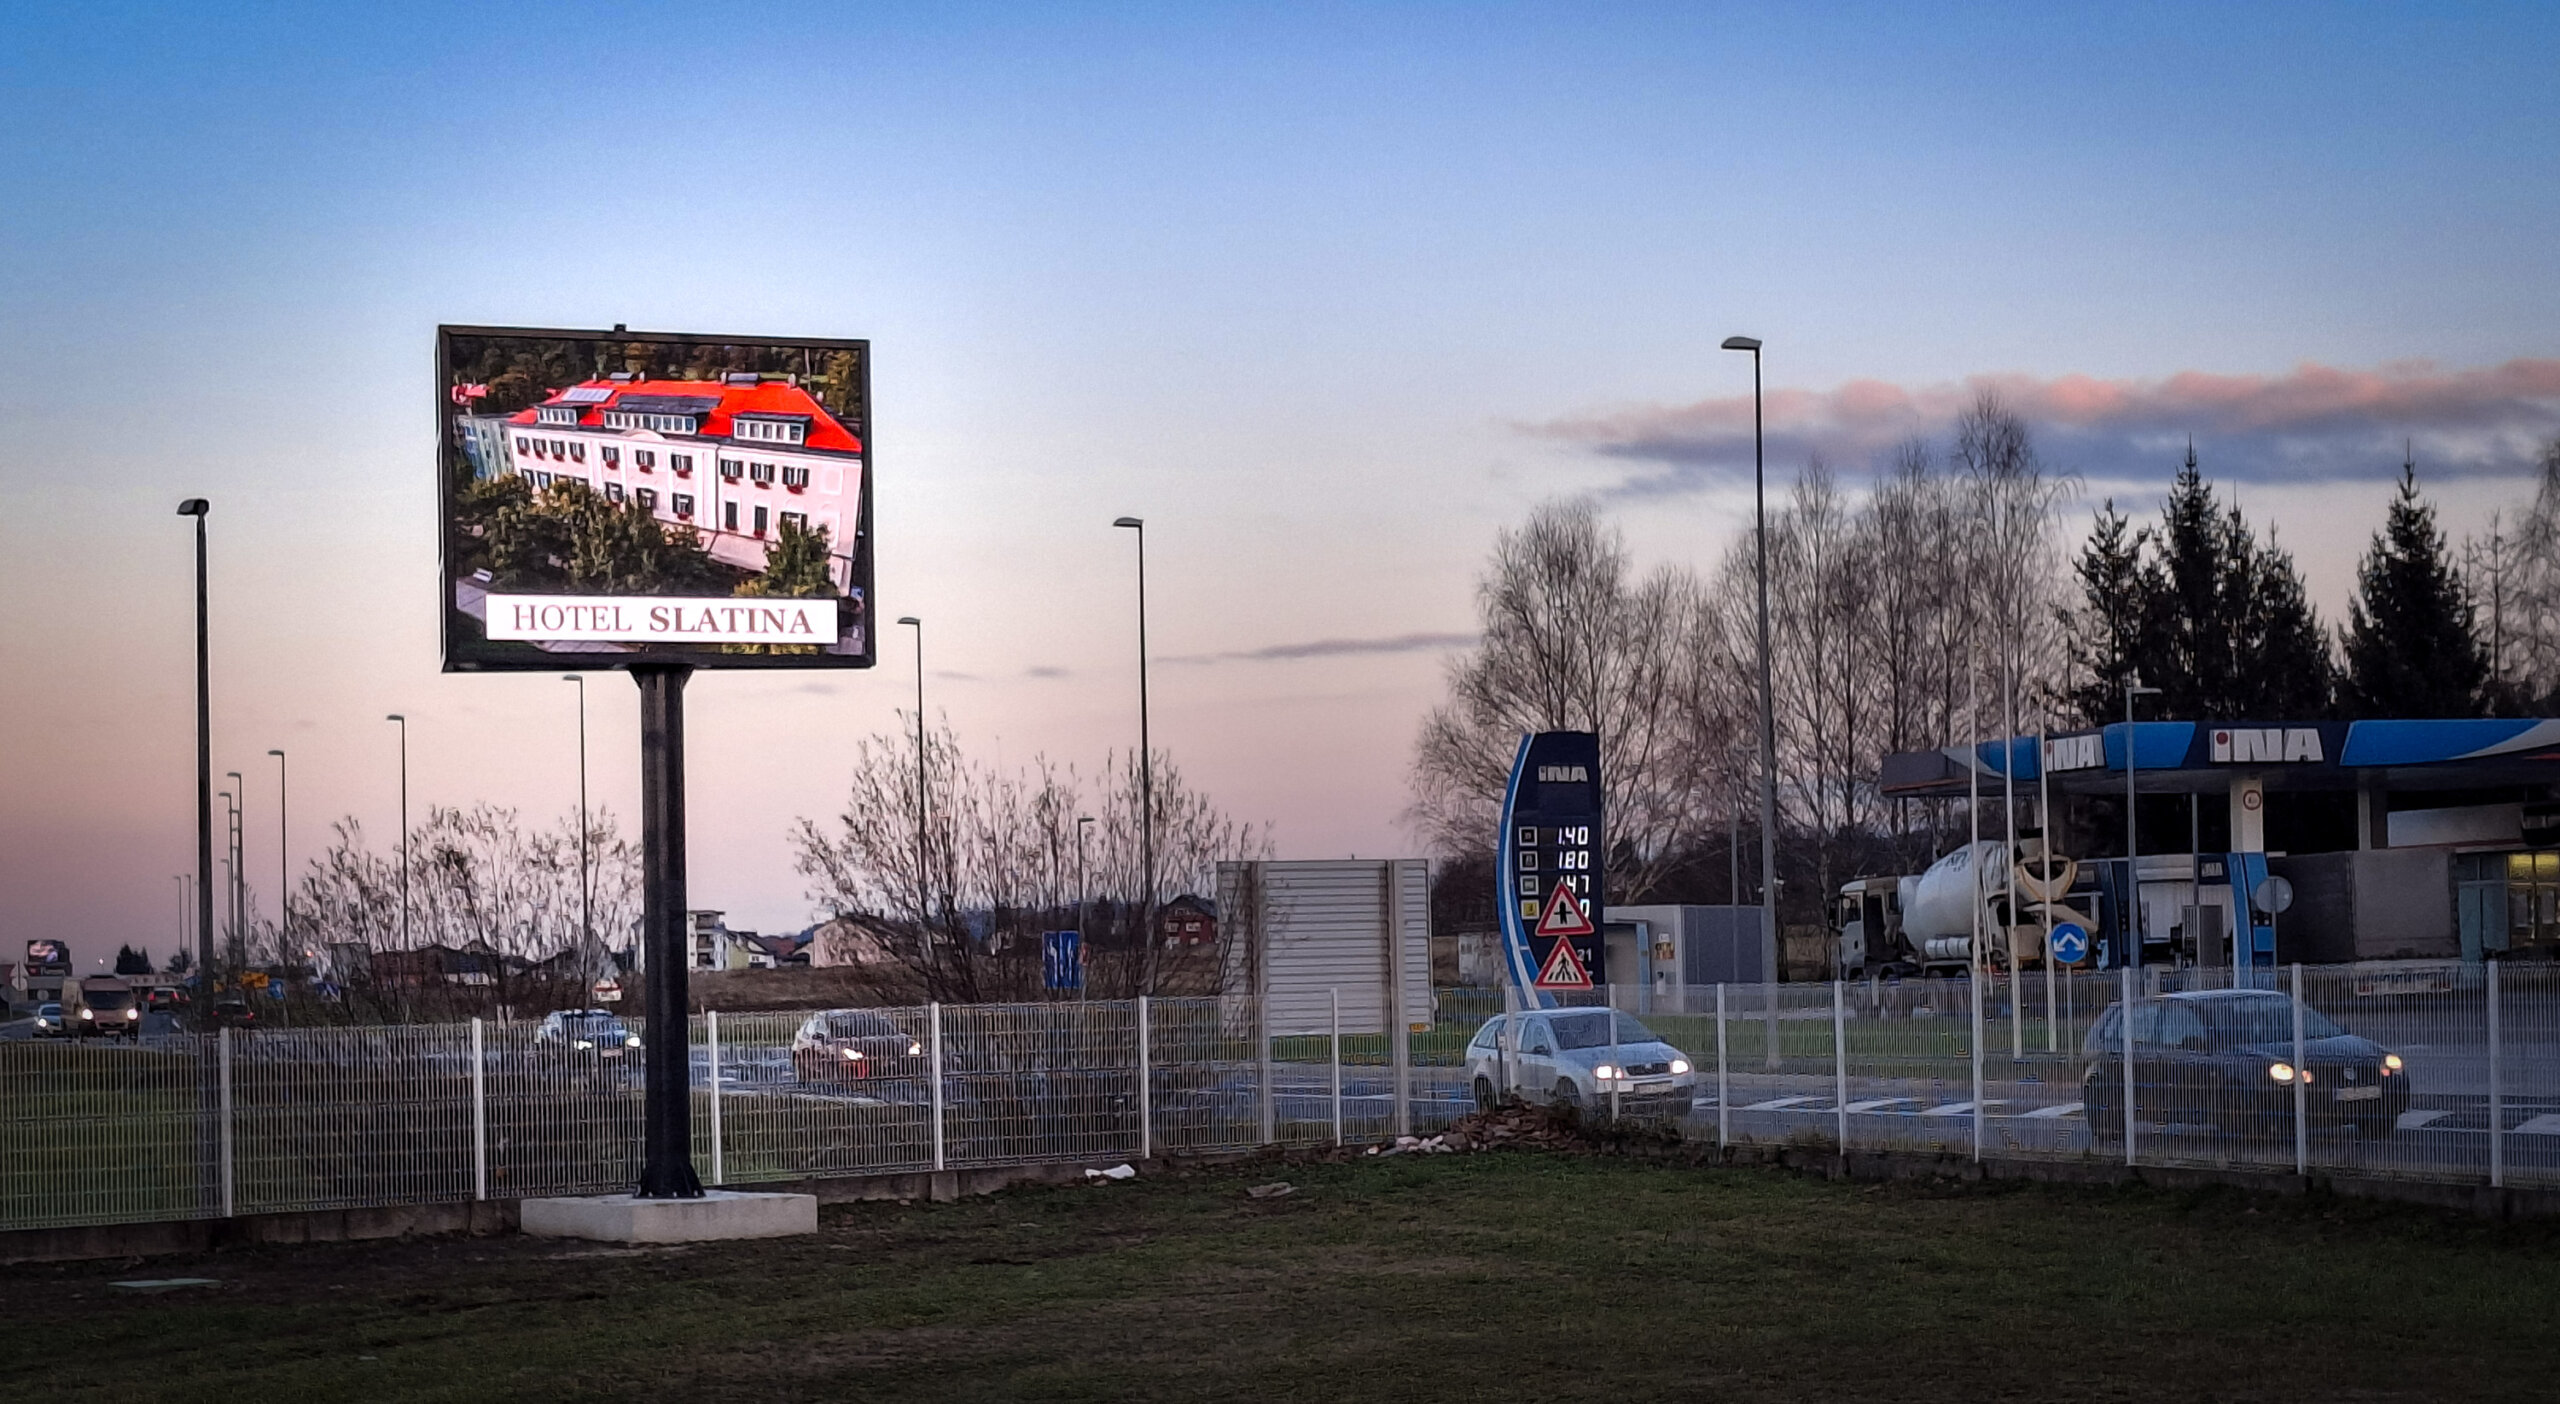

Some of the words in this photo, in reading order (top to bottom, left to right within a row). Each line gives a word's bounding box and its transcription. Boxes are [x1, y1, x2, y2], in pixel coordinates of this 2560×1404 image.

[513, 604, 633, 632] HOTEL
[649, 606, 814, 634] SLATINA
[1558, 826, 1589, 846] 1.40
